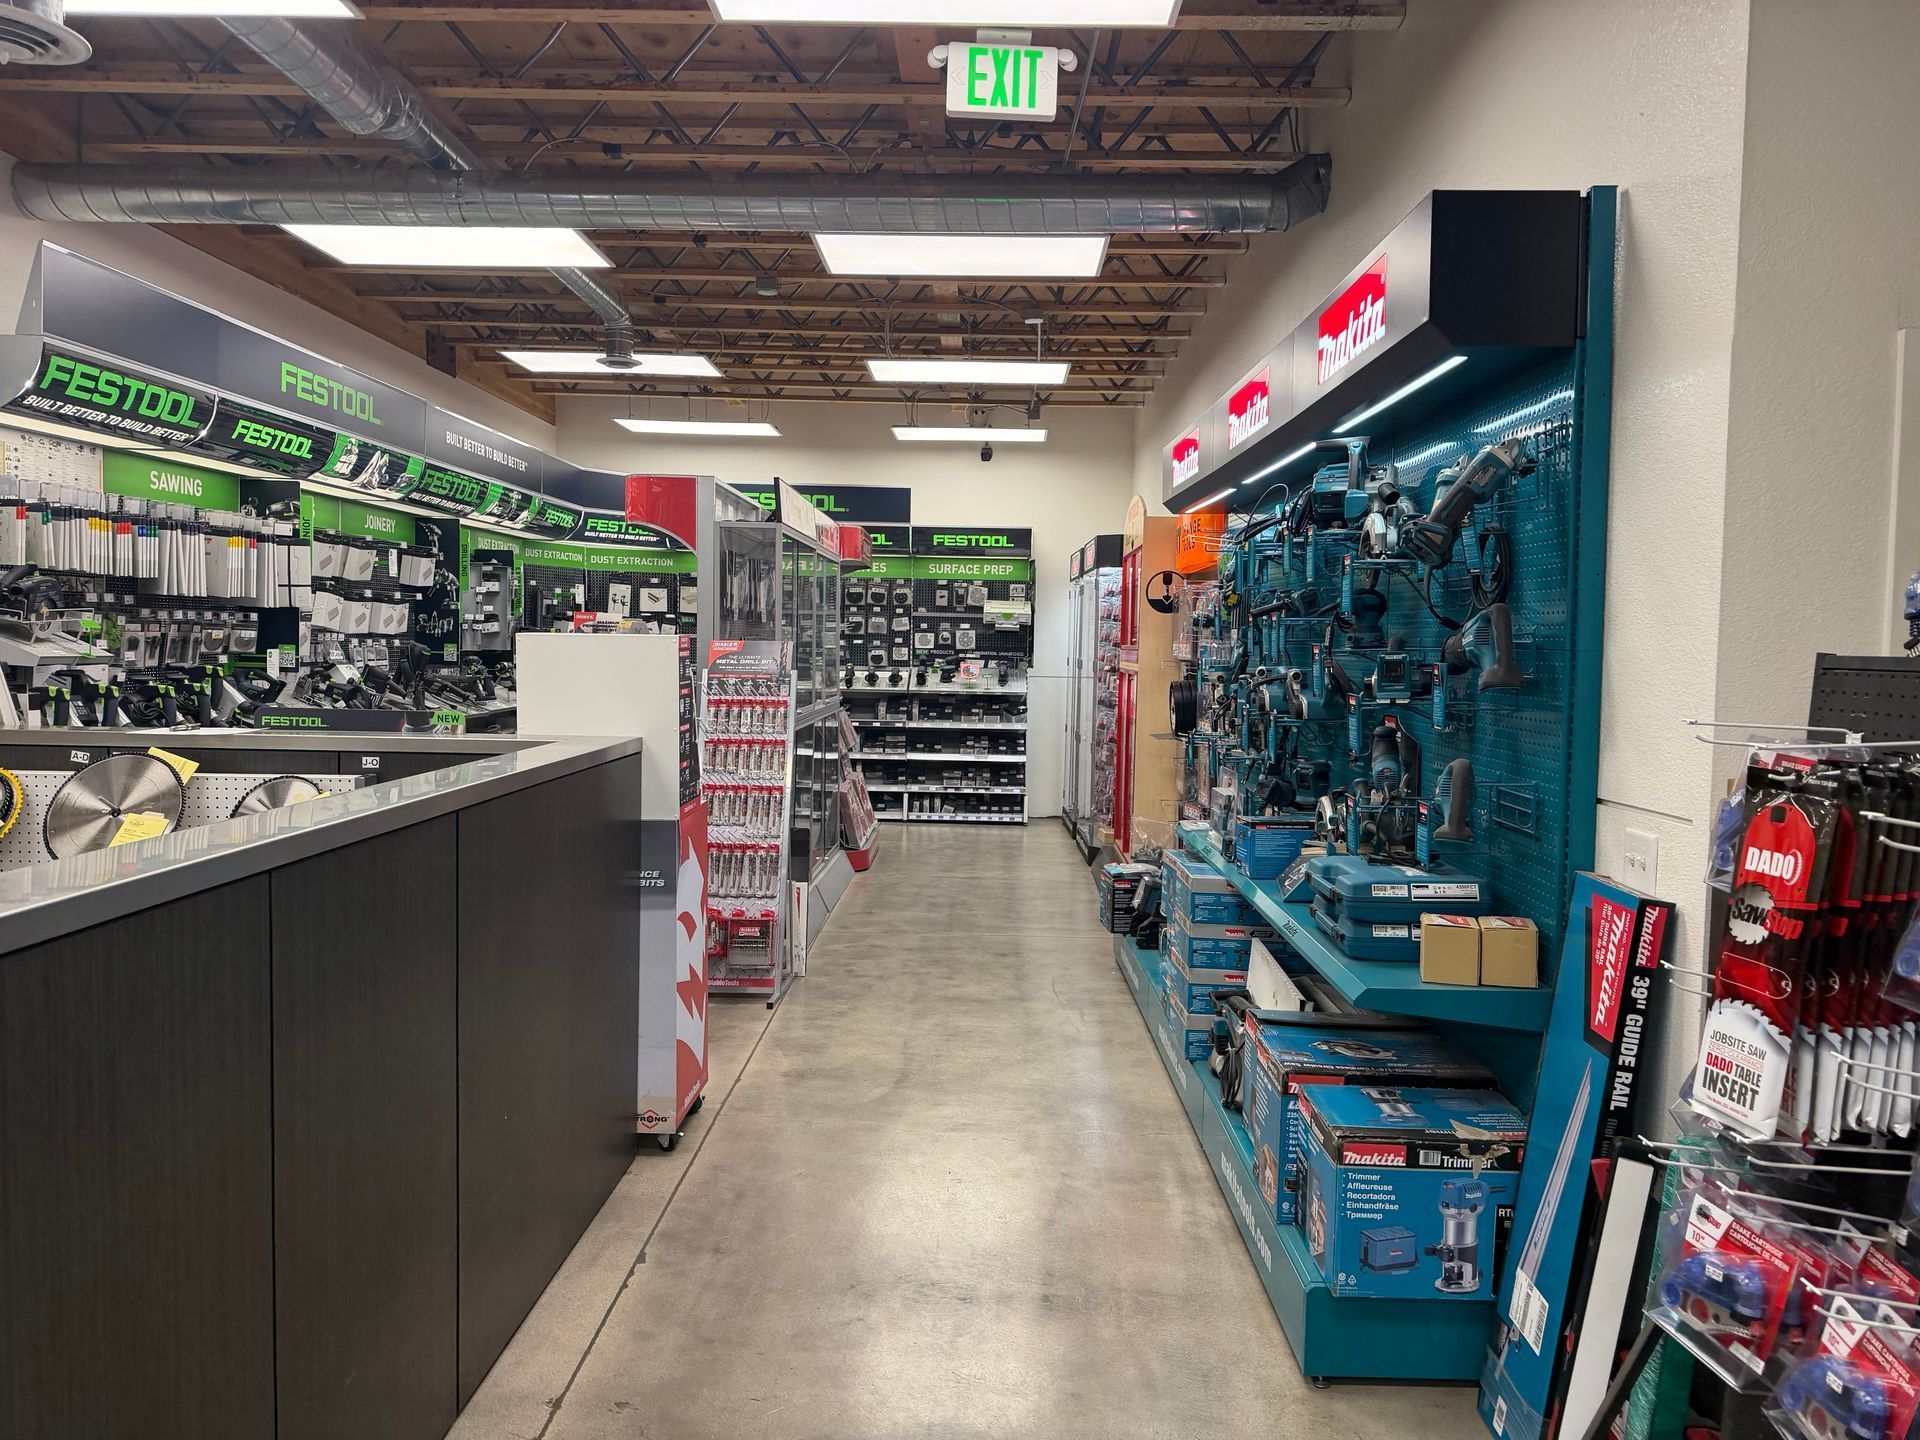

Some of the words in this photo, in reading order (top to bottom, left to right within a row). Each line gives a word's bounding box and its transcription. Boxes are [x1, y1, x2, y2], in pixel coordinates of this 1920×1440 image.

[967, 46, 1043, 109] EXIT
[40, 355, 202, 429] FESTOOL
[281, 361, 382, 426] FESTOOL
[22, 394, 63, 411] BUILT
[59, 404, 105, 422] BETTER
[104, 414, 121, 426] TO
[118, 418, 152, 433] BUILD
[231, 419, 313, 459] FESTOOL
[445, 430, 463, 448] BUILT
[463, 437, 485, 457] BETTER
[485, 445, 493, 459] TO
[493, 448, 507, 465] BUILD
[149, 470, 203, 497] SAWING
[420, 468, 480, 503] FESTOOL
[364, 513, 396, 533] JOINERY
[478, 537, 491, 549] DUST
[491, 539, 520, 555] EXTRACTION
[525, 548, 542, 558] DUST
[543, 550, 583, 562] EXTRACTION
[933, 534, 1015, 547] FESTOOL
[590, 555, 614, 564] DUST
[617, 556, 674, 567] EXTRACTION
[928, 563, 981, 575] SURFACE
[984, 563, 1014, 575] PREP
[261, 715, 328, 727] FESTOOL
[437, 714, 460, 723] NEW
[71, 753, 89, 761] A-D
[362, 758, 379, 767] J-O
[1744, 846, 1795, 880] DADO
[1601, 922, 1610, 946] GUIDE
[1731, 897, 1804, 940] SawStop
[1597, 947, 1606, 966] RAIL
[1617, 1012, 1644, 1068] GUIDE
[1709, 1029, 1747, 1053] JOBSITE
[1747, 1043, 1767, 1061] SAW
[1705, 1051, 1734, 1075] DADO
[1734, 1063, 1762, 1088] TABLE
[1609, 1070, 1633, 1112] RAIL
[1702, 1066, 1760, 1112] INSERT
[1346, 1182, 1394, 1192] Affleureuse
[1347, 1172, 1381, 1182] Trimmer
[1221, 1151, 1272, 1273] makitatools.com
[1346, 1191, 1397, 1201] Recortadora
[1346, 1200, 1400, 1212] Einhandfräse
[1346, 1210, 1384, 1221] Триммер
[1729, 1228, 1762, 1256] CARTOUCHE
[1761, 1249, 1772, 1261] DE
[1731, 1220, 1752, 1239] BRAKE
[1751, 1234, 1785, 1260] CARTRIDGE
[1861, 1337, 1893, 1374] CARTOUCHE
[1890, 1367, 1901, 1381] DE
[1865, 1329, 1883, 1352] BRAKE
[1882, 1346, 1912, 1382] CARTRIDGE
